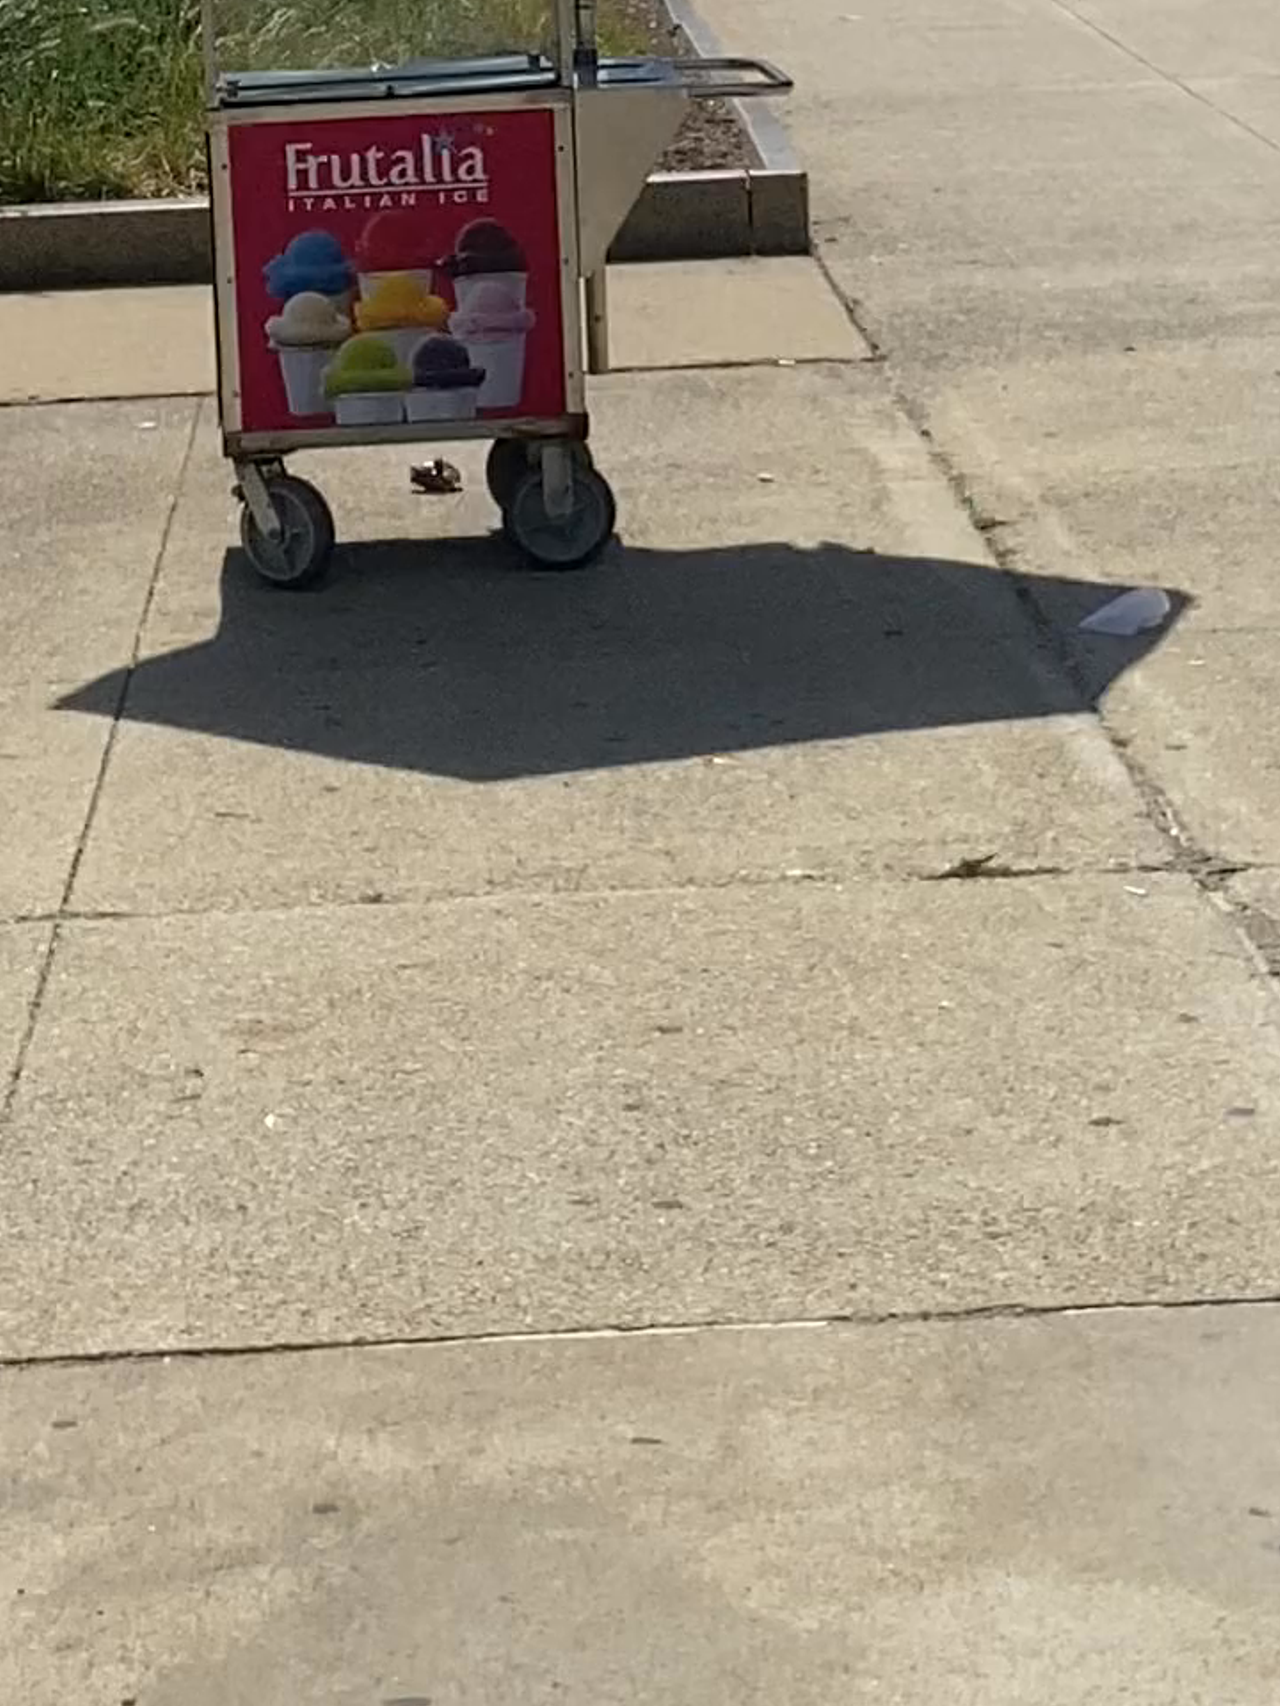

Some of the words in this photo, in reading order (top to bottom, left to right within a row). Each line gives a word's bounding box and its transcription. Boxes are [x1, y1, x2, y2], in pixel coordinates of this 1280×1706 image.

[285, 133, 488, 190] Frutalia
[288, 194, 417, 212] ITALIAN
[438, 189, 488, 205] ICE
